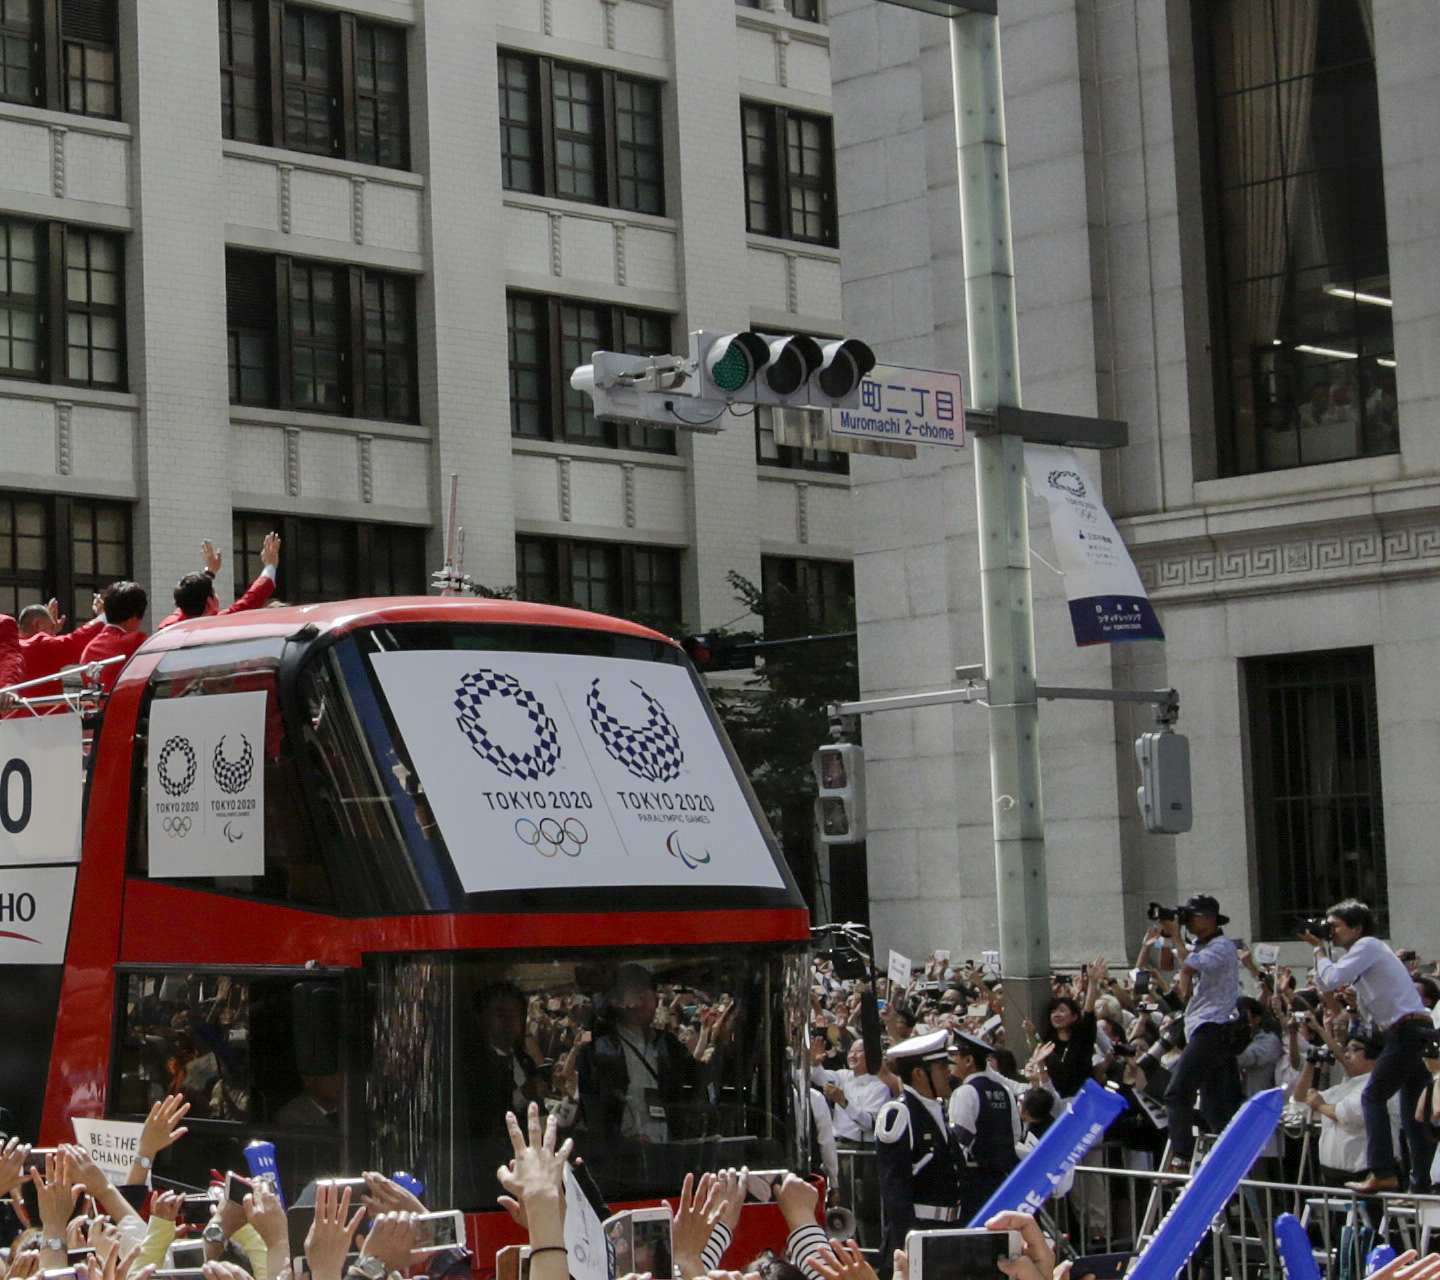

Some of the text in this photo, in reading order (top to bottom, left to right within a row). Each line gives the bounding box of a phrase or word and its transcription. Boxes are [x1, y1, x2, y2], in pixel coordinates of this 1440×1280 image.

[862, 378, 954, 421] 町二丁目
[841, 411, 954, 440] Muromachi 2-chome
[156, 801, 199, 813] TOKYO 2020
[211, 799, 256, 811] TOKYO 2020
[483, 790, 593, 811] TOKYO 2020
[617, 791, 715, 812] TOKYO 2020
[638, 813, 711, 824] PARALYMPIC GAMES
[90, 1133, 138, 1150] BE THE
